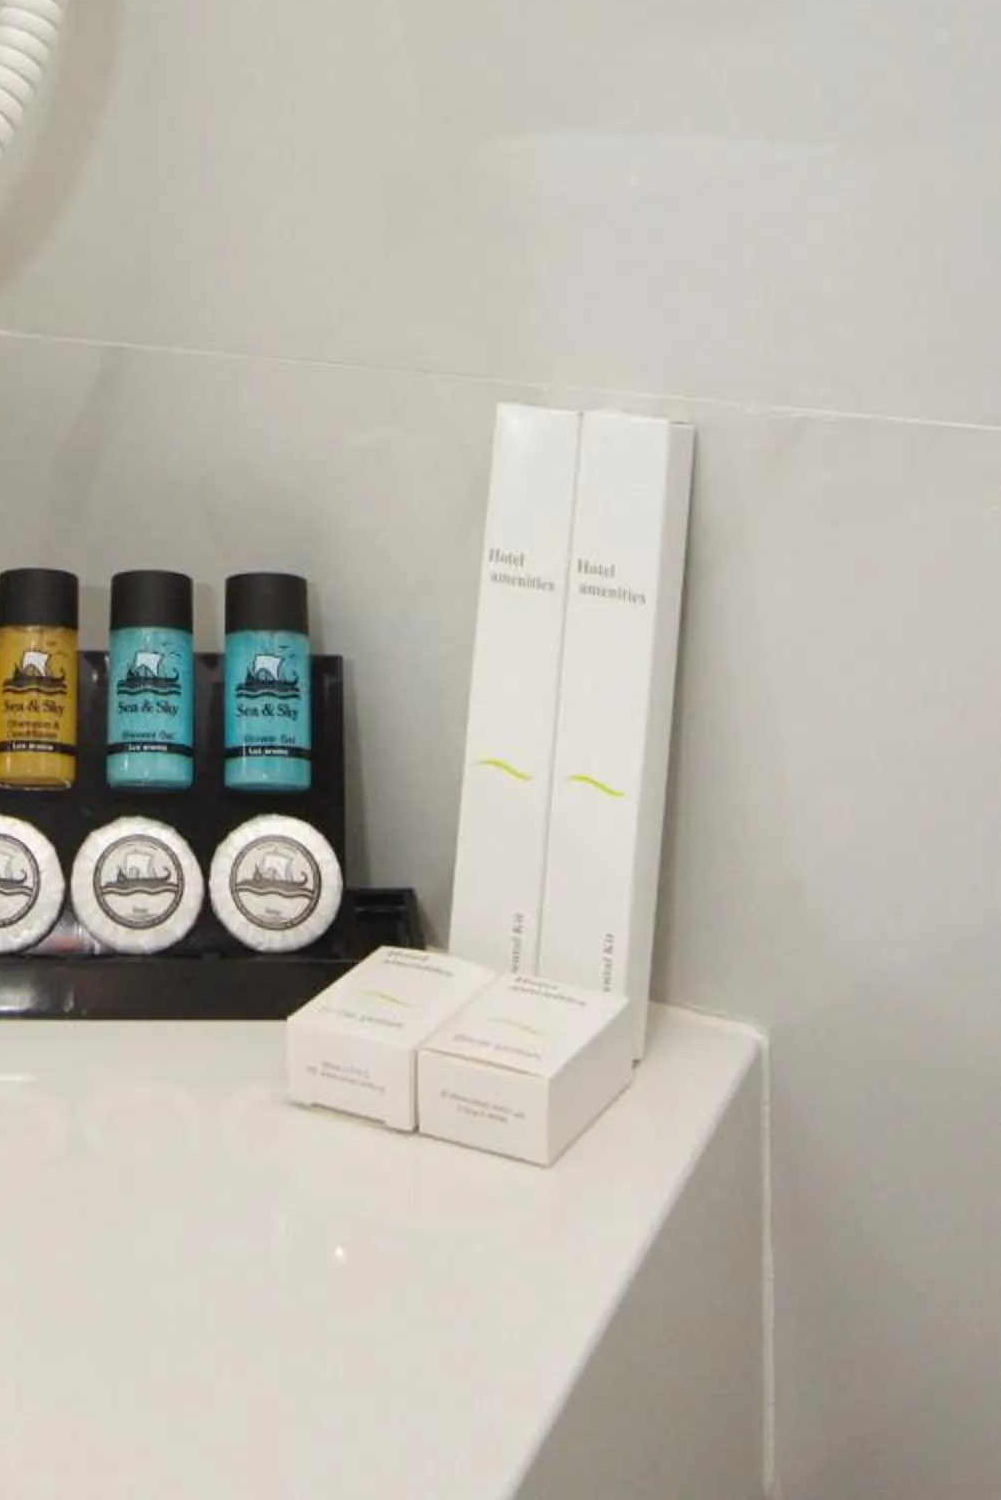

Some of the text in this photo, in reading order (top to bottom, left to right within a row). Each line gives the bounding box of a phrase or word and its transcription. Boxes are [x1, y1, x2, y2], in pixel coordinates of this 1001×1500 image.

[488, 548, 525, 567] Hotel
[577, 558, 616, 578] Hotel
[490, 570, 556, 592] amenities
[579, 582, 647, 605] amenities
[118, 701, 138, 714] Sea
[235, 704, 259, 717] Sea
[261, 704, 275, 717] &
